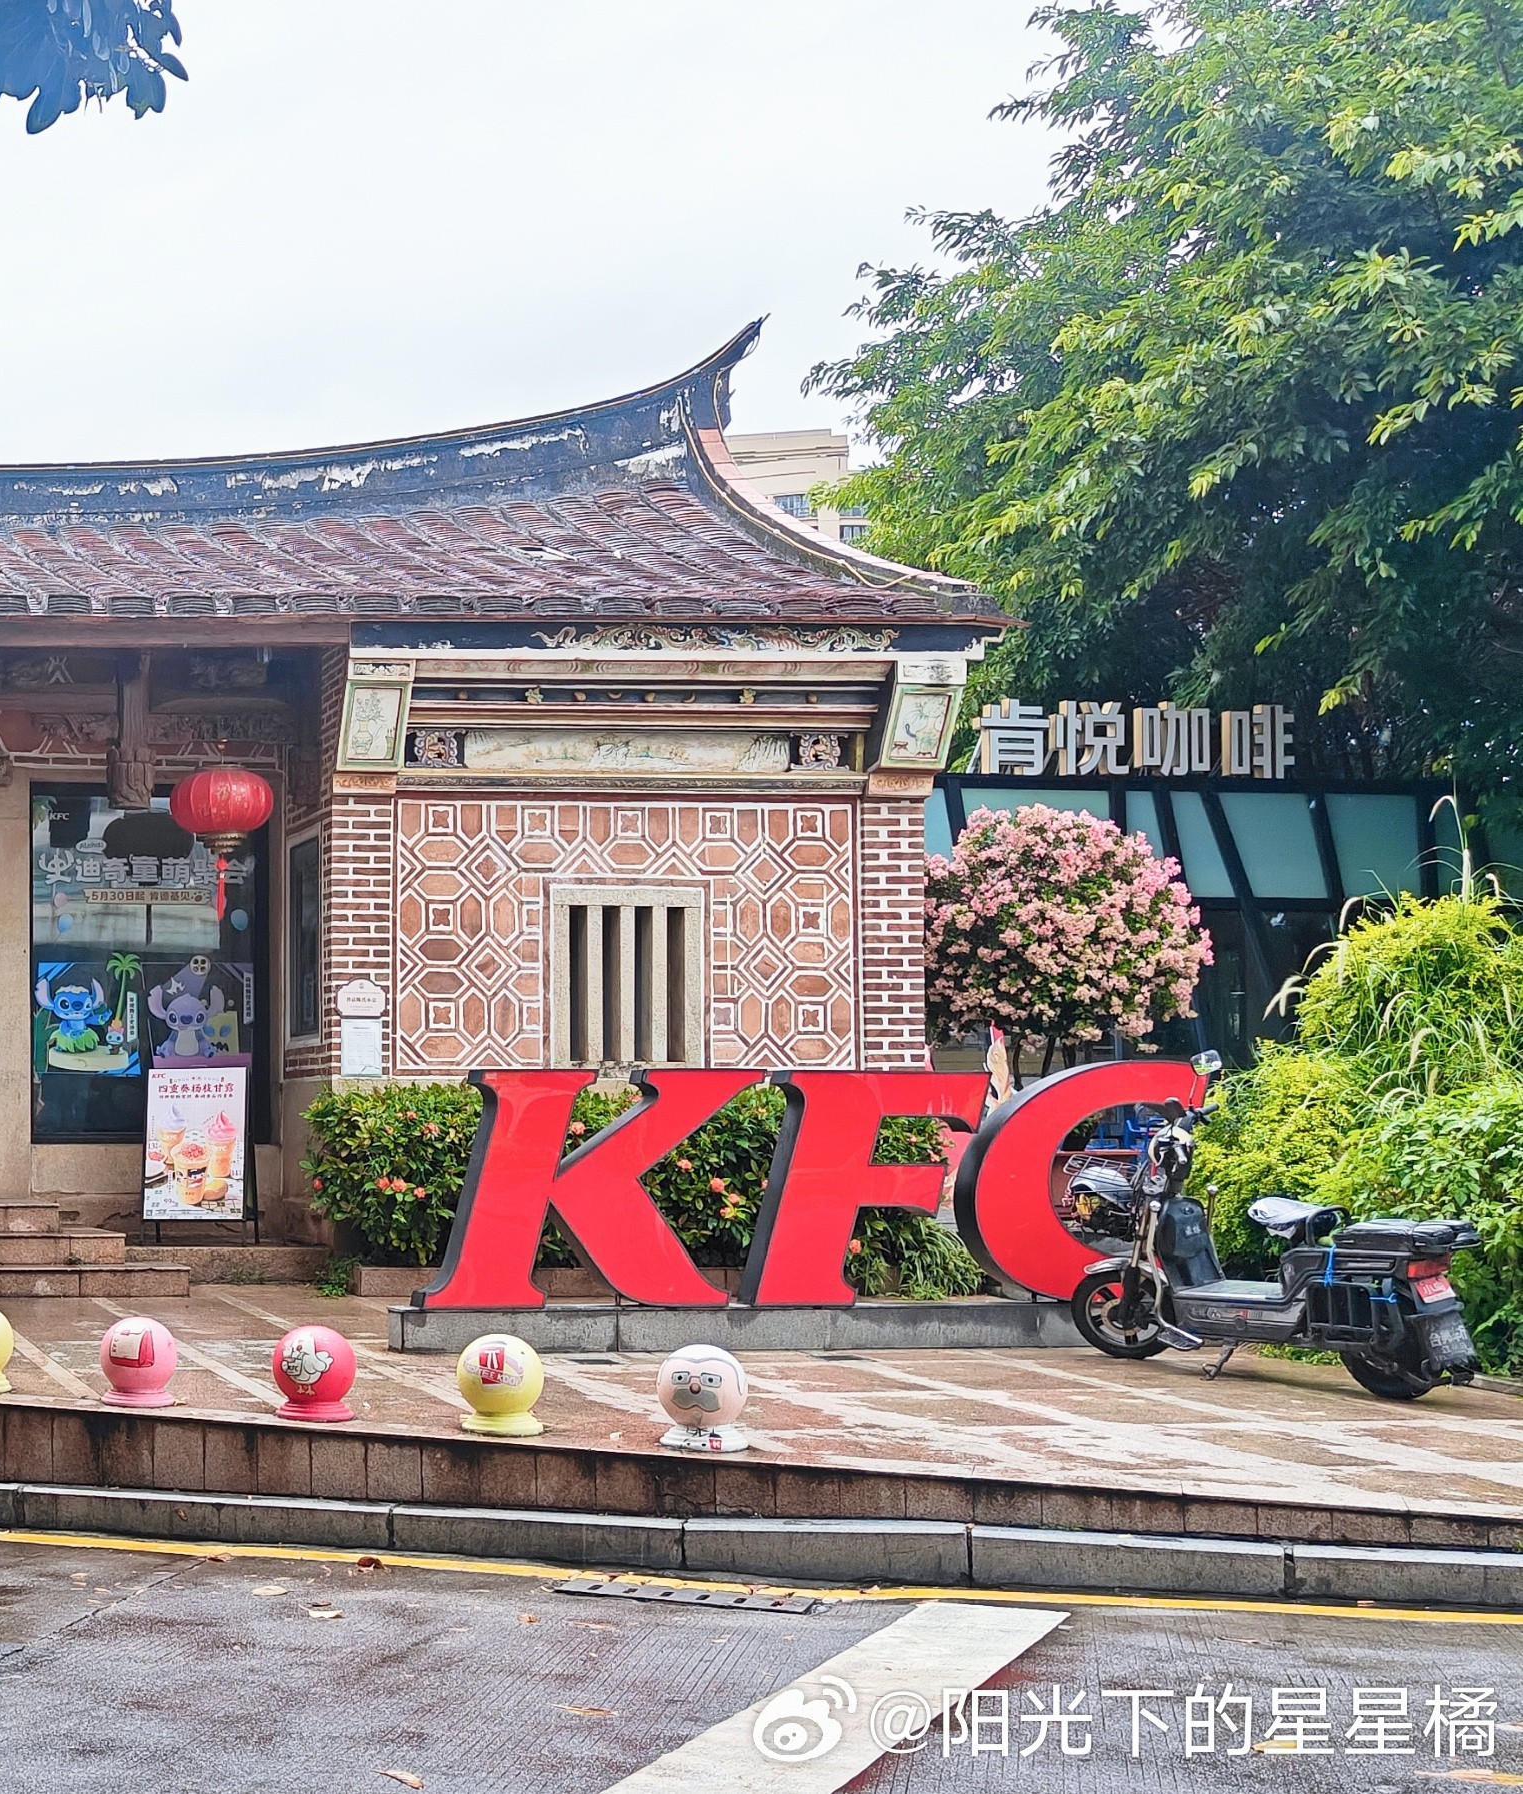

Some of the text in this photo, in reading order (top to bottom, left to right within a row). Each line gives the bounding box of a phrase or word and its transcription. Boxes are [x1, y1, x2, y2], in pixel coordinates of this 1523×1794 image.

[978, 699, 1295, 779] 肯悦咖啡
[49, 812, 70, 821] KFC
[91, 891, 146, 902] 5月30日起
[410, 1060, 1207, 1309] KFC
